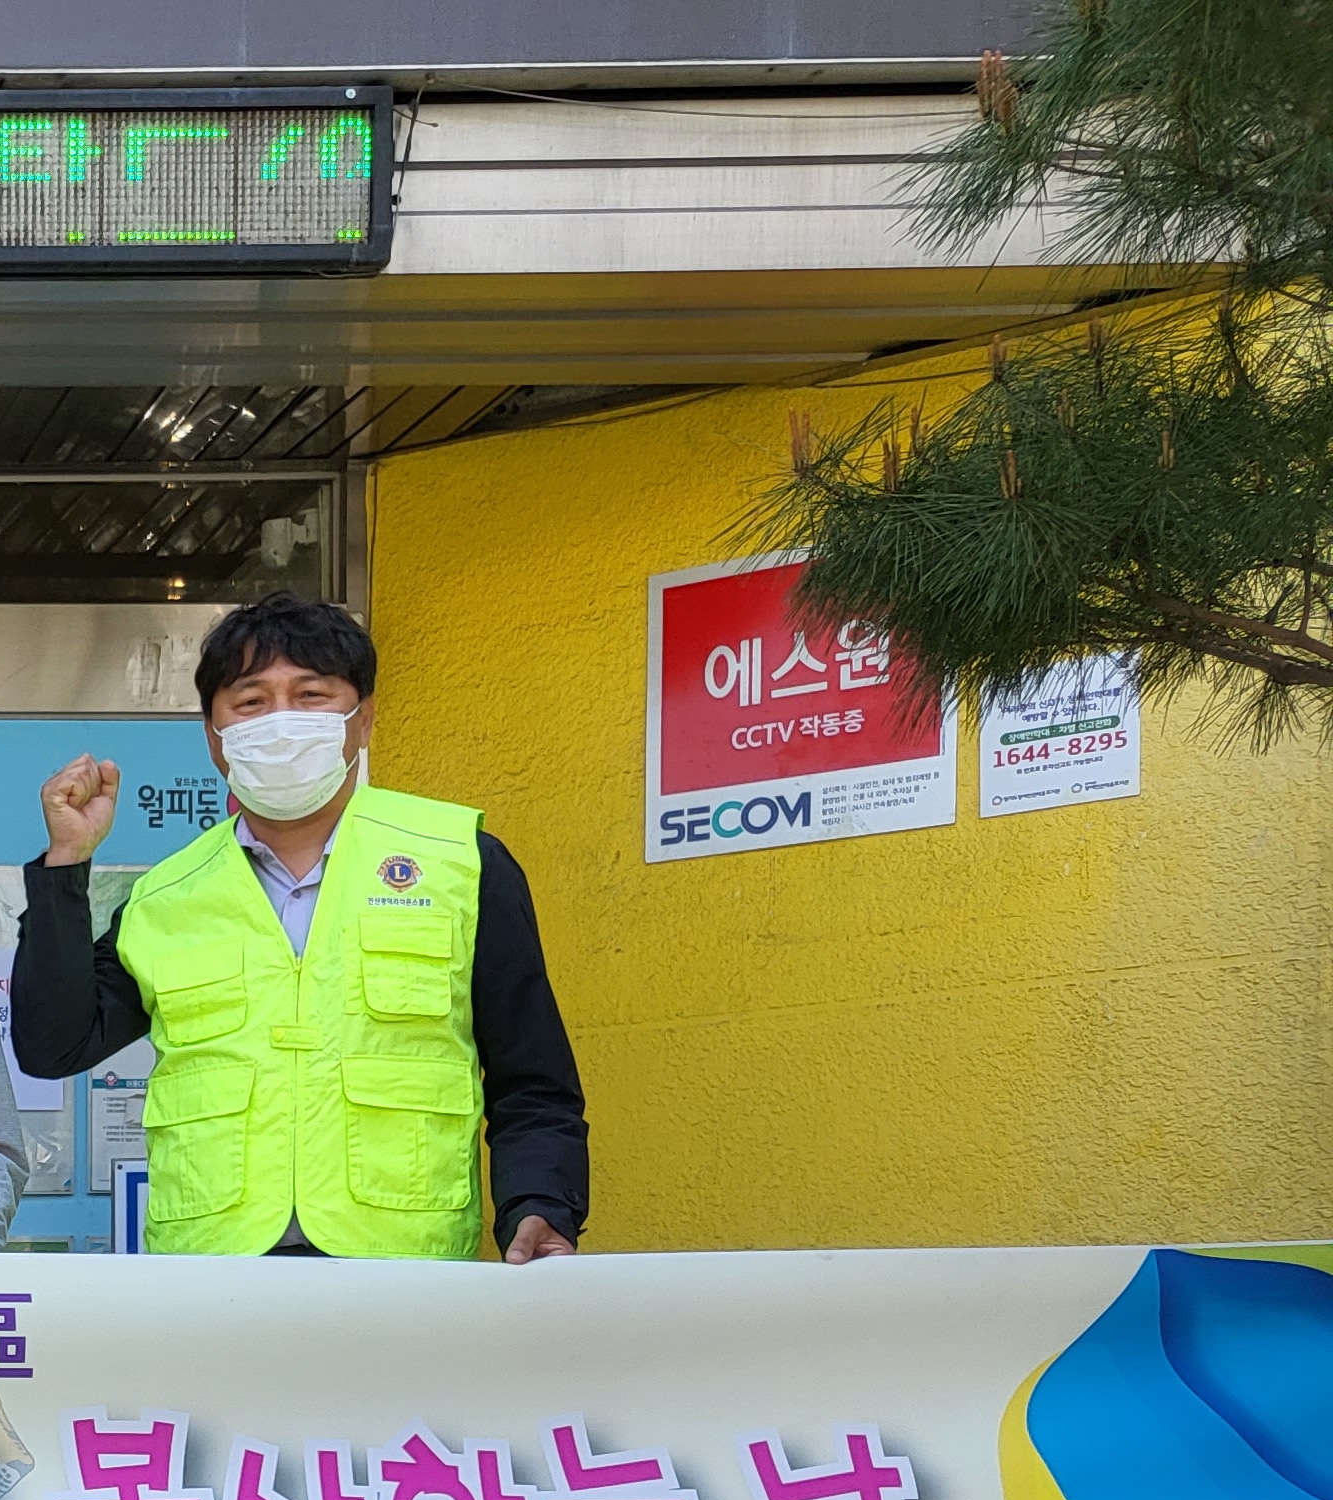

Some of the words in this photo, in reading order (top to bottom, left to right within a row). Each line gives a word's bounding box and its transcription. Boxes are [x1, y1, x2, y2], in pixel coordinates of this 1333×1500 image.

[703, 619, 890, 708] 에스원
[731, 720, 794, 750] CCTV
[799, 708, 865, 738] 작동중
[993, 730, 1127, 768] 1644-8295
[138, 785, 220, 831] 월피동
[660, 791, 812, 846] SECOM
